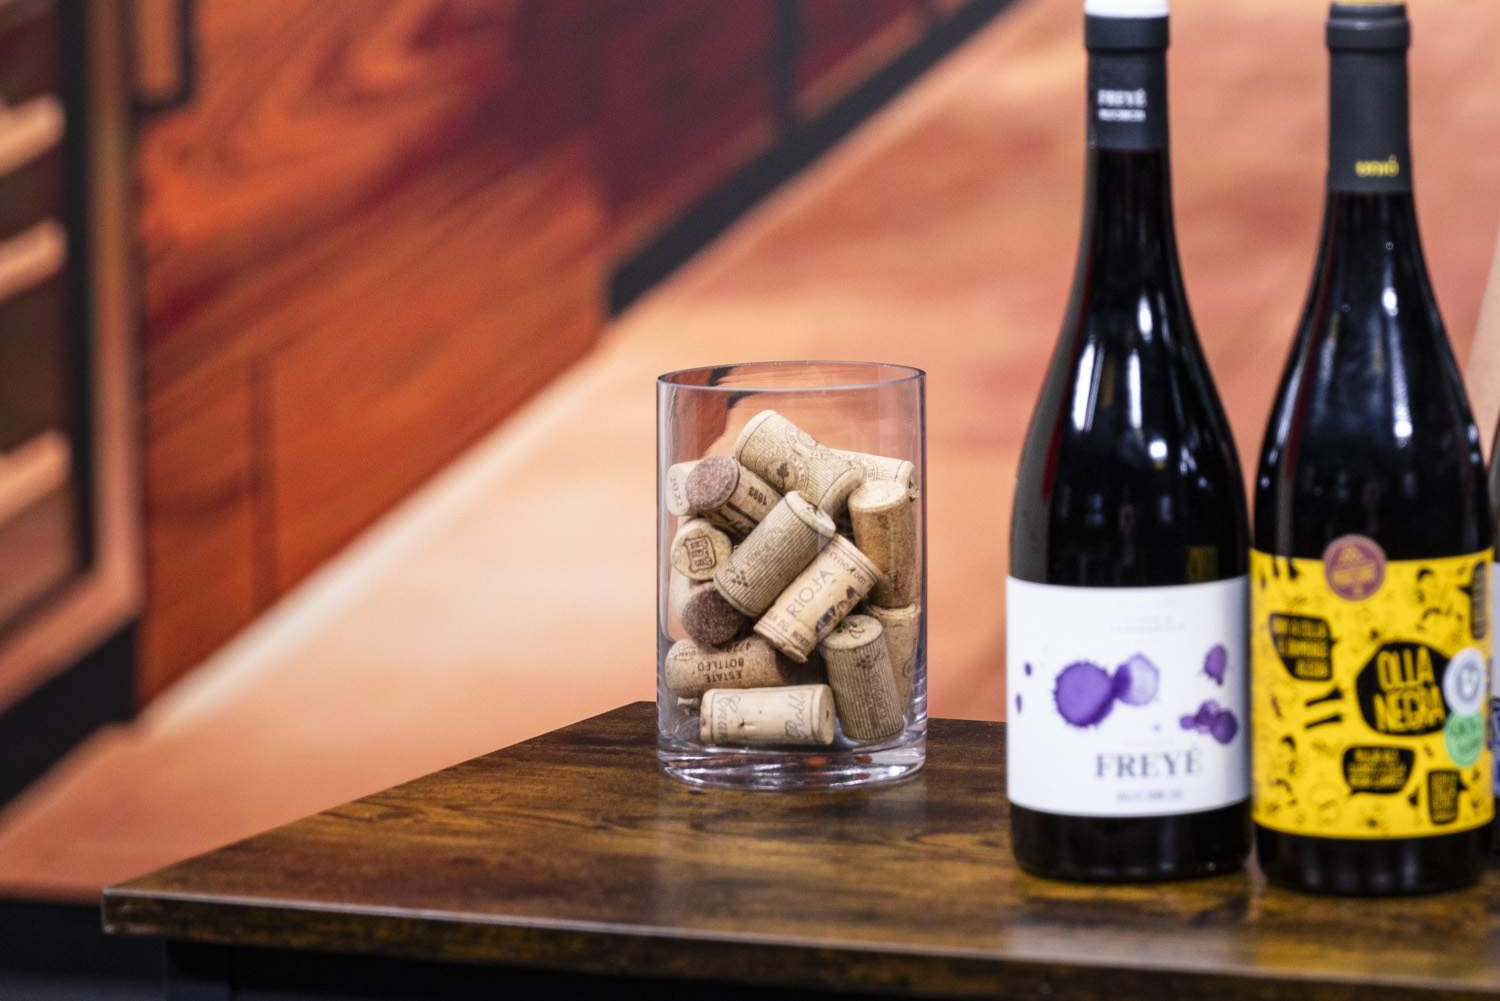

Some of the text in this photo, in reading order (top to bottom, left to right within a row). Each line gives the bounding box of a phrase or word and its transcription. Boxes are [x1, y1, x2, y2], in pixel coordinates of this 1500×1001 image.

[788, 567, 834, 621] RIOJA
[697, 657, 745, 672] BOTTLED
[703, 669, 743, 684] ESTATE
[1375, 646, 1436, 693] OLLA
[1373, 684, 1447, 734] NEGRA
